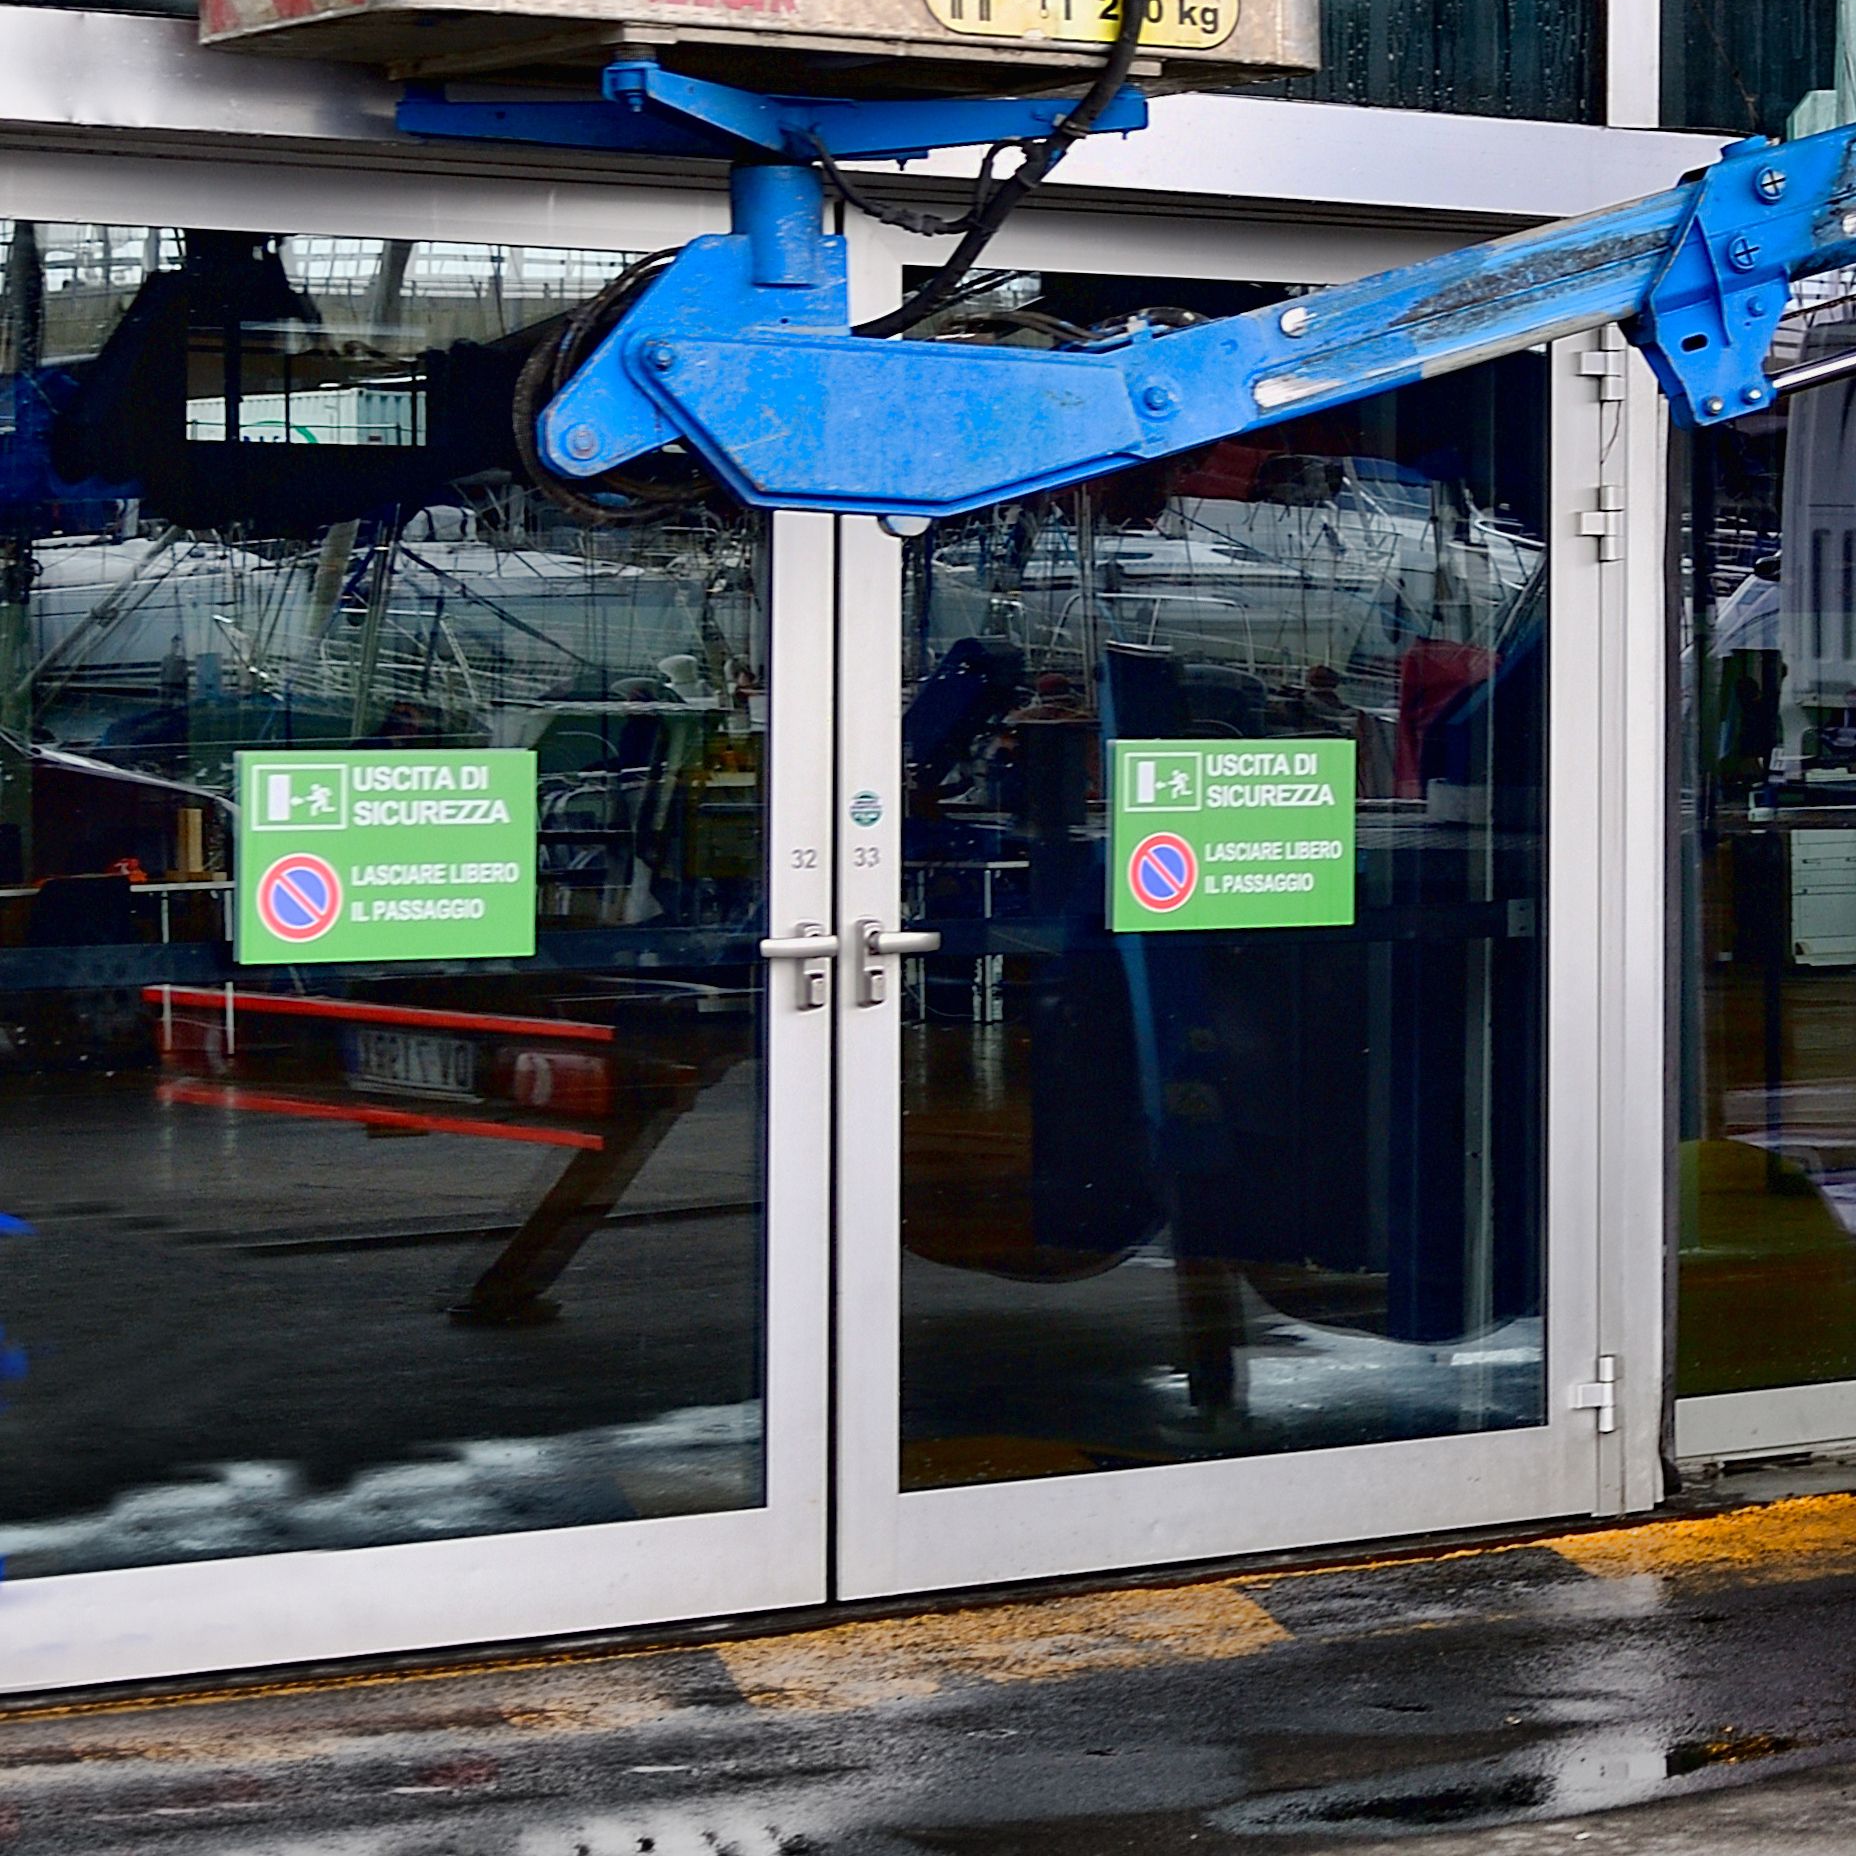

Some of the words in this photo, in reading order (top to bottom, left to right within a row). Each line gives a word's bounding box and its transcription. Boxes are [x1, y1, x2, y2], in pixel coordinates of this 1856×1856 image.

[1205, 752, 1291, 777] USCITA
[1294, 752, 1318, 776] DI
[351, 765, 456, 792] USCITA
[459, 765, 489, 791] DI
[1205, 783, 1335, 808] SICUREZZA
[351, 798, 511, 826] SICUREZZA
[791, 848, 818, 869] 32
[853, 846, 880, 867] 33
[1204, 841, 1284, 863] LASCIARE
[1284, 839, 1344, 861] LIBERO
[350, 862, 448, 887] LASCIARE
[449, 861, 520, 884] LIBERO
[1204, 874, 1220, 894] IL
[1221, 872, 1315, 894] PASSAGGIO
[350, 900, 370, 922] IL
[372, 897, 485, 922] PASSAGGIO
